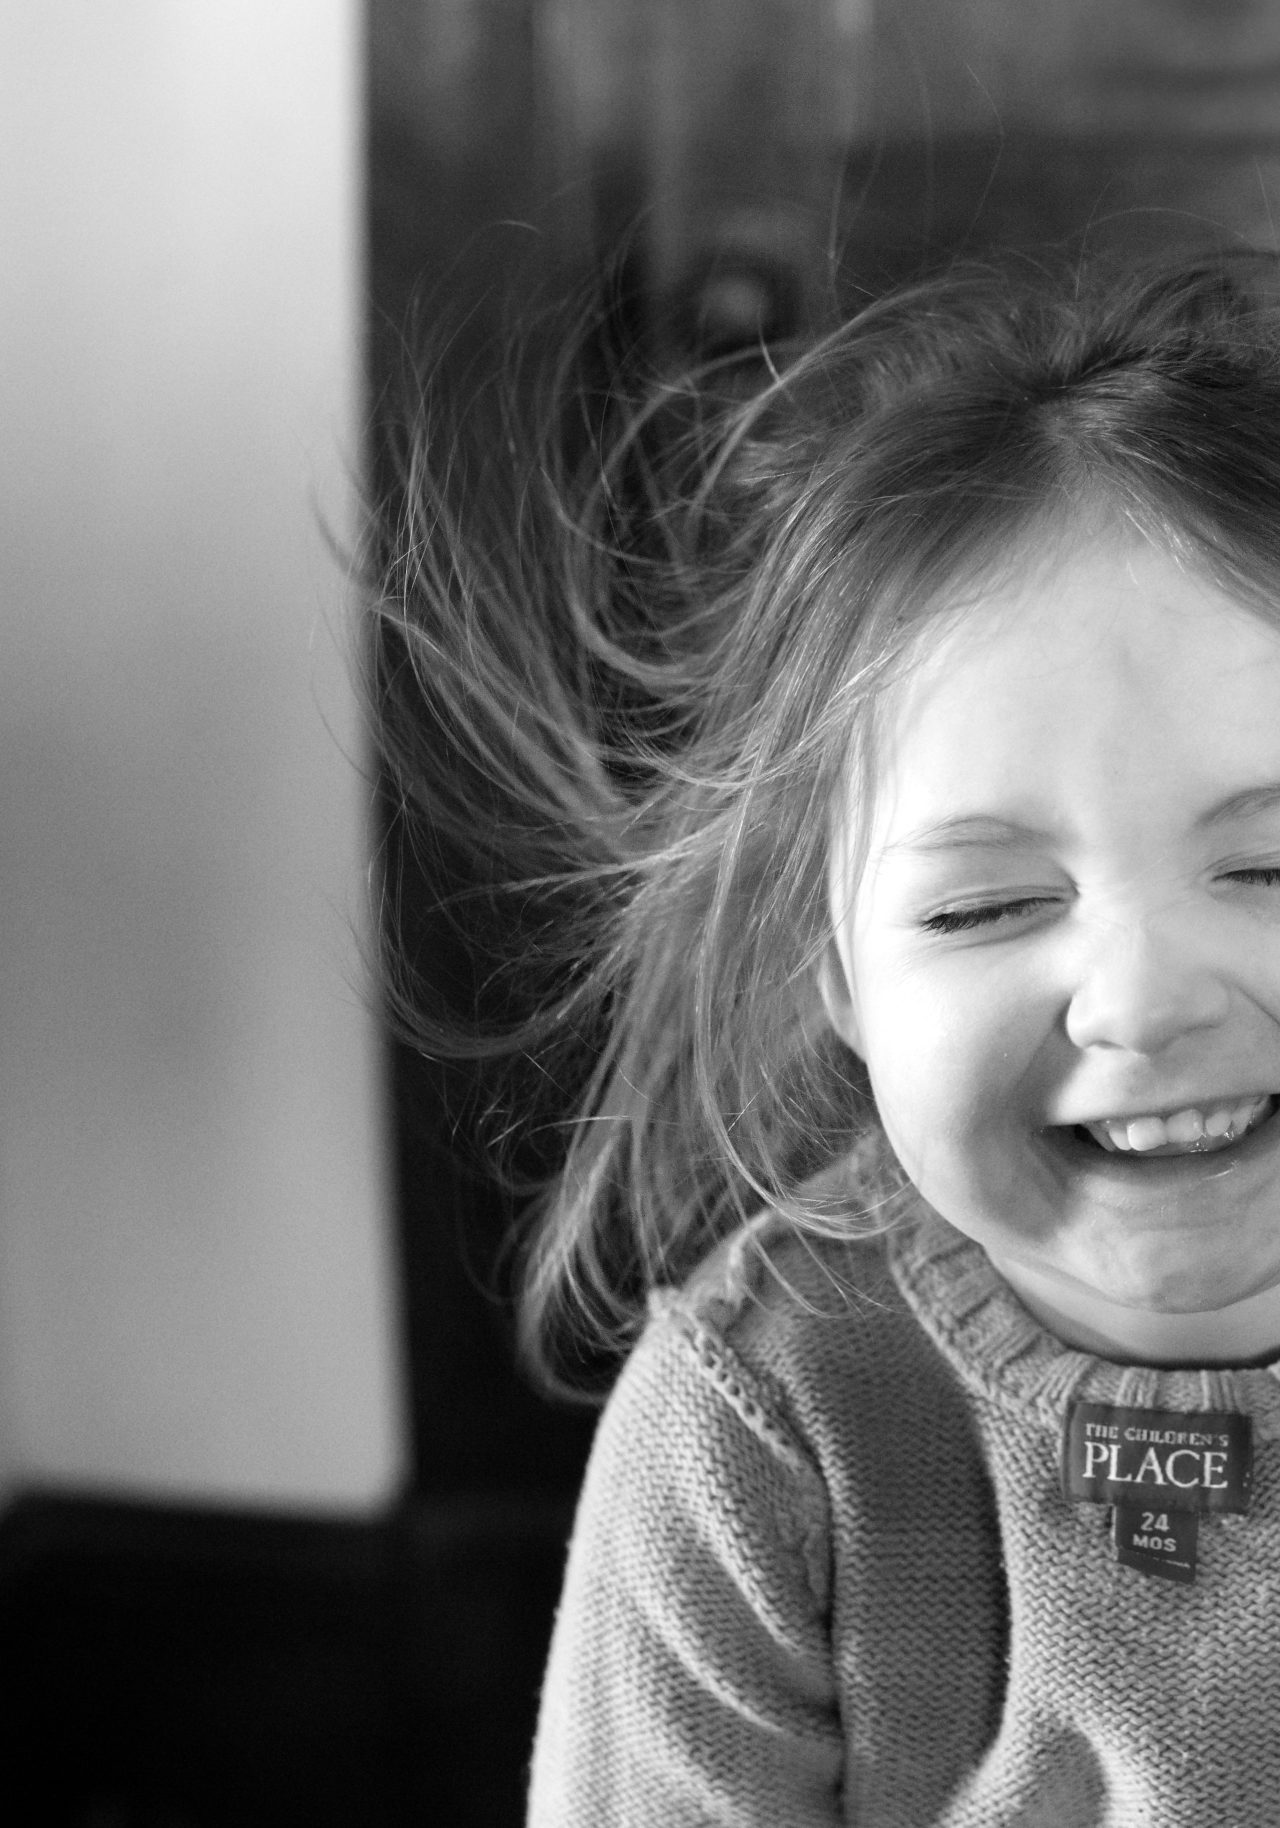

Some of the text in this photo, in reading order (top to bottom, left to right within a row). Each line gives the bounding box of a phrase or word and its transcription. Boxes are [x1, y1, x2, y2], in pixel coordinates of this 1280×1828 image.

[1086, 1423, 1229, 1447] THE CHILDREN'S
[1082, 1441, 1228, 1489] PLACE
[1140, 1512, 1170, 1532] 24
[1133, 1534, 1177, 1552] MOS
